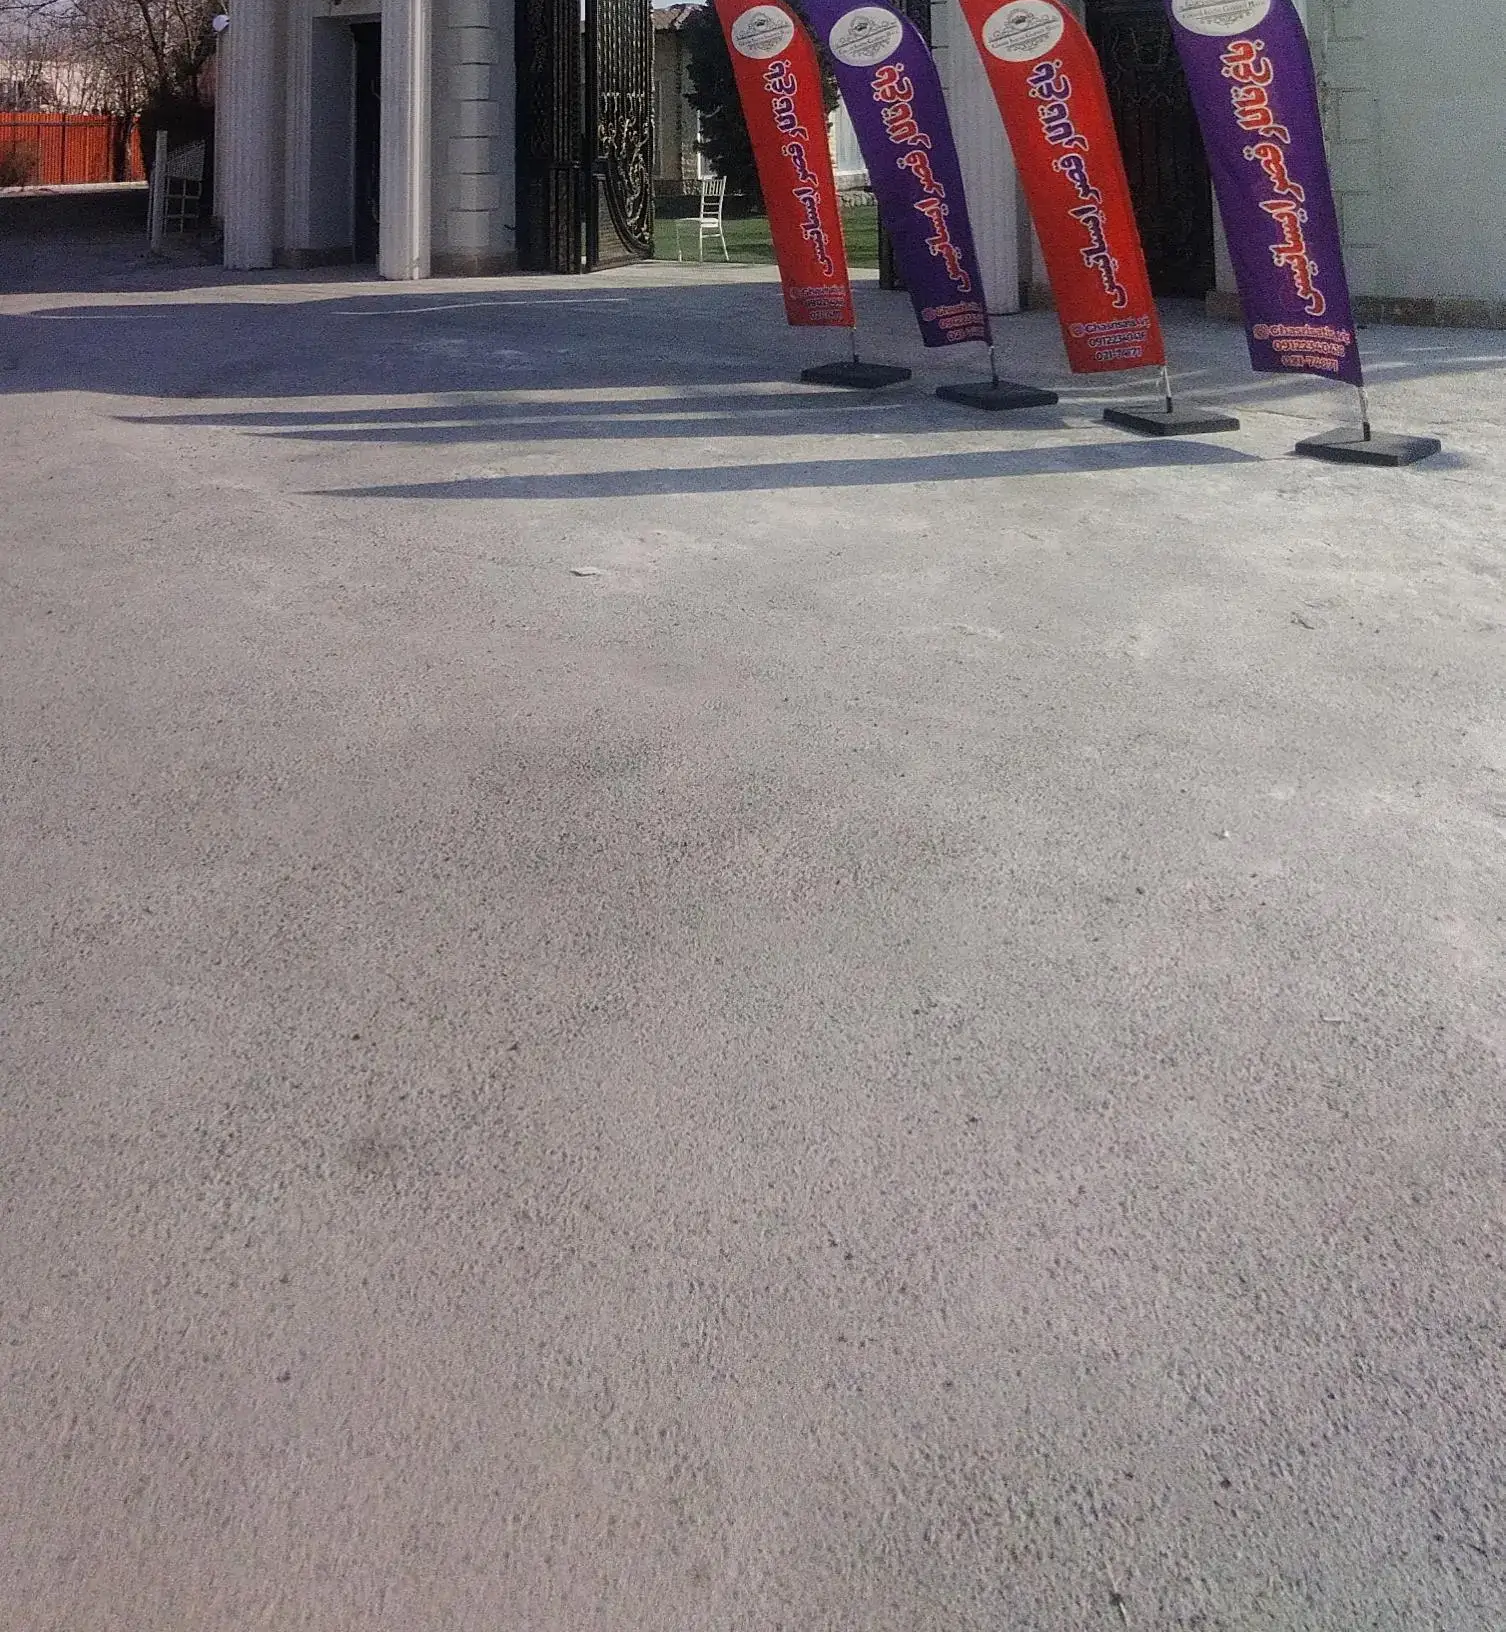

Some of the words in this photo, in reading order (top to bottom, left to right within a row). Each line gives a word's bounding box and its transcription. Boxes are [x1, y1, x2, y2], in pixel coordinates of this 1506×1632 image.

[763, 59, 798, 97] باغ
[871, 62, 914, 103] باغ
[1026, 59, 1073, 102] باغ
[1219, 39, 1274, 86] باغ
[771, 97, 810, 142] تالار
[881, 102, 932, 149] تالار
[1038, 101, 1089, 152] تالار
[1230, 84, 1291, 145] تالار
[782, 141, 820, 188] قصر
[897, 149, 945, 199] قصر
[1052, 151, 1104, 202] قصر
[1242, 142, 1306, 203] قصر
[1068, 204, 1128, 309] ایساتیس
[1258, 198, 1326, 317] ایساتیس
